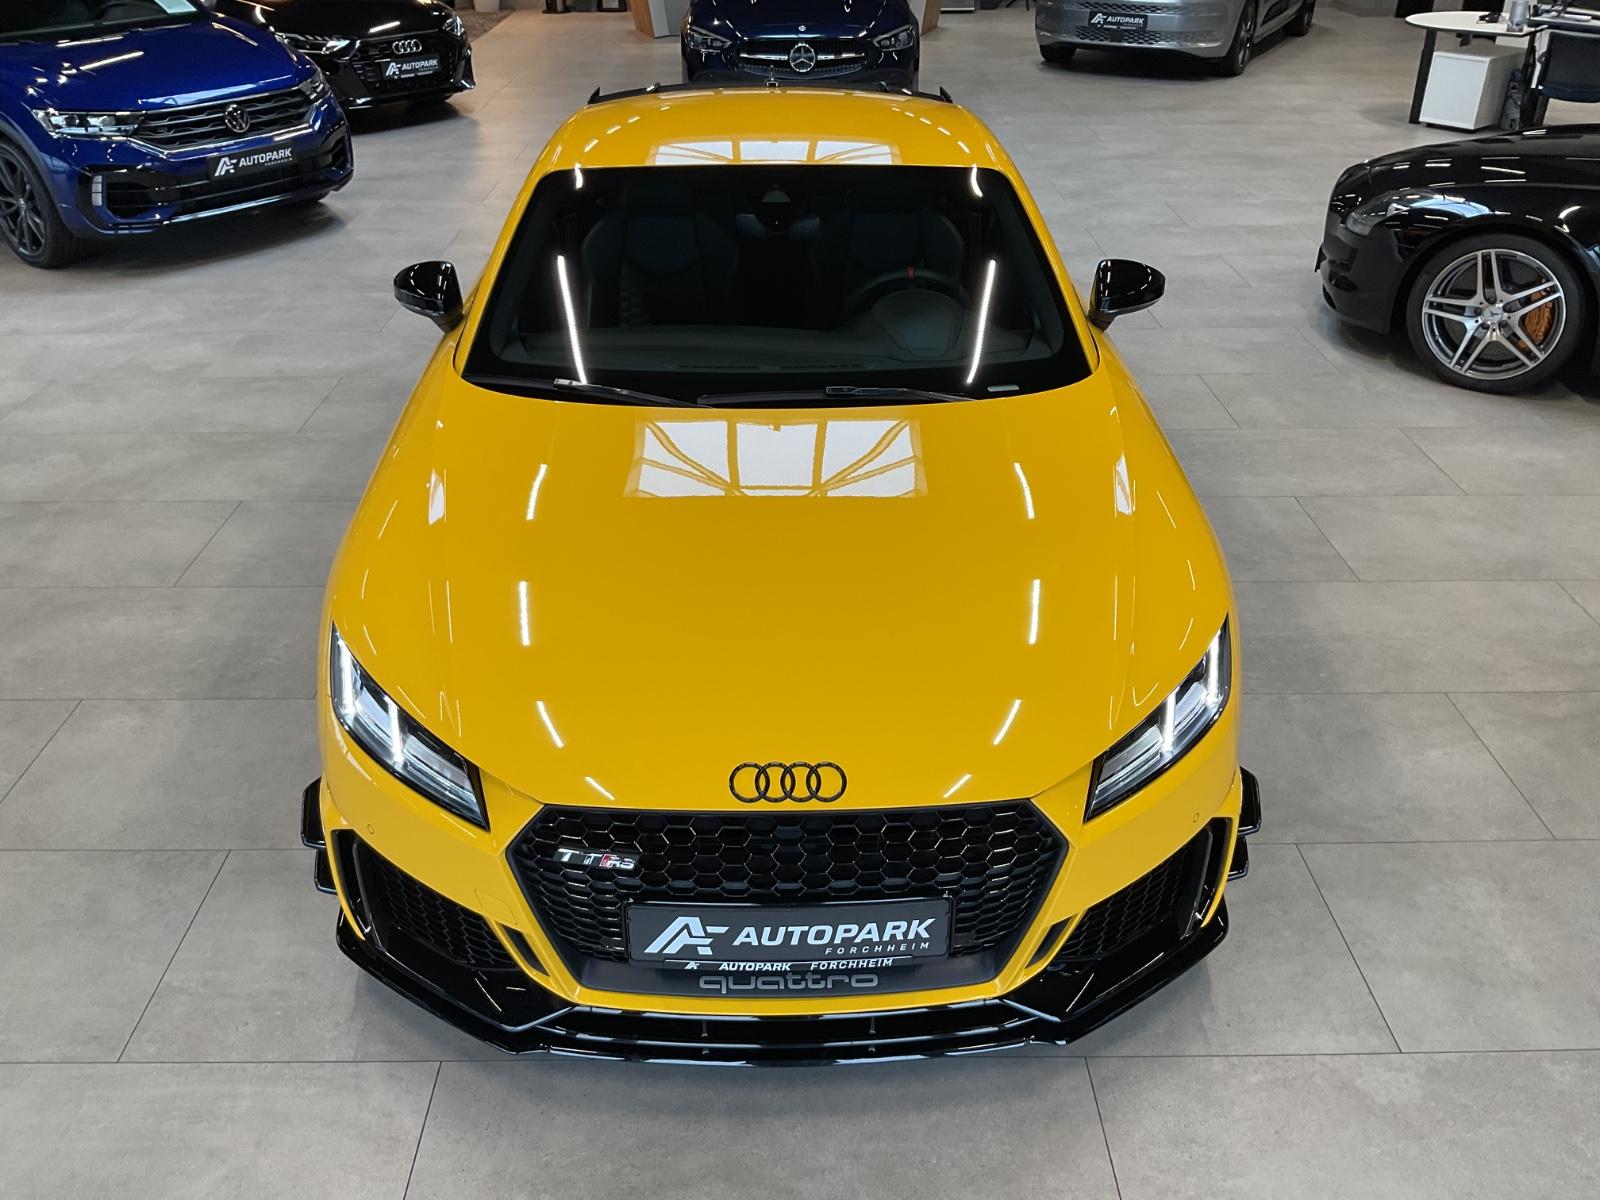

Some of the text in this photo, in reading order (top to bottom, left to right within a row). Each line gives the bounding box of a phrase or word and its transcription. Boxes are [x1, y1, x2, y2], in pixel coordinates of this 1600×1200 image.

[1106, 16, 1145, 24] AUTOPARK
[401, 59, 438, 70] AUTOPARK
[239, 147, 292, 168] AUTOPARK
[732, 918, 936, 946] AUTOPARK
[825, 941, 930, 955] FORCHHEIM
[718, 962, 792, 971] AUTOPARK
[810, 958, 894, 971] FORCHHEIM
[699, 972, 879, 994] quattro
